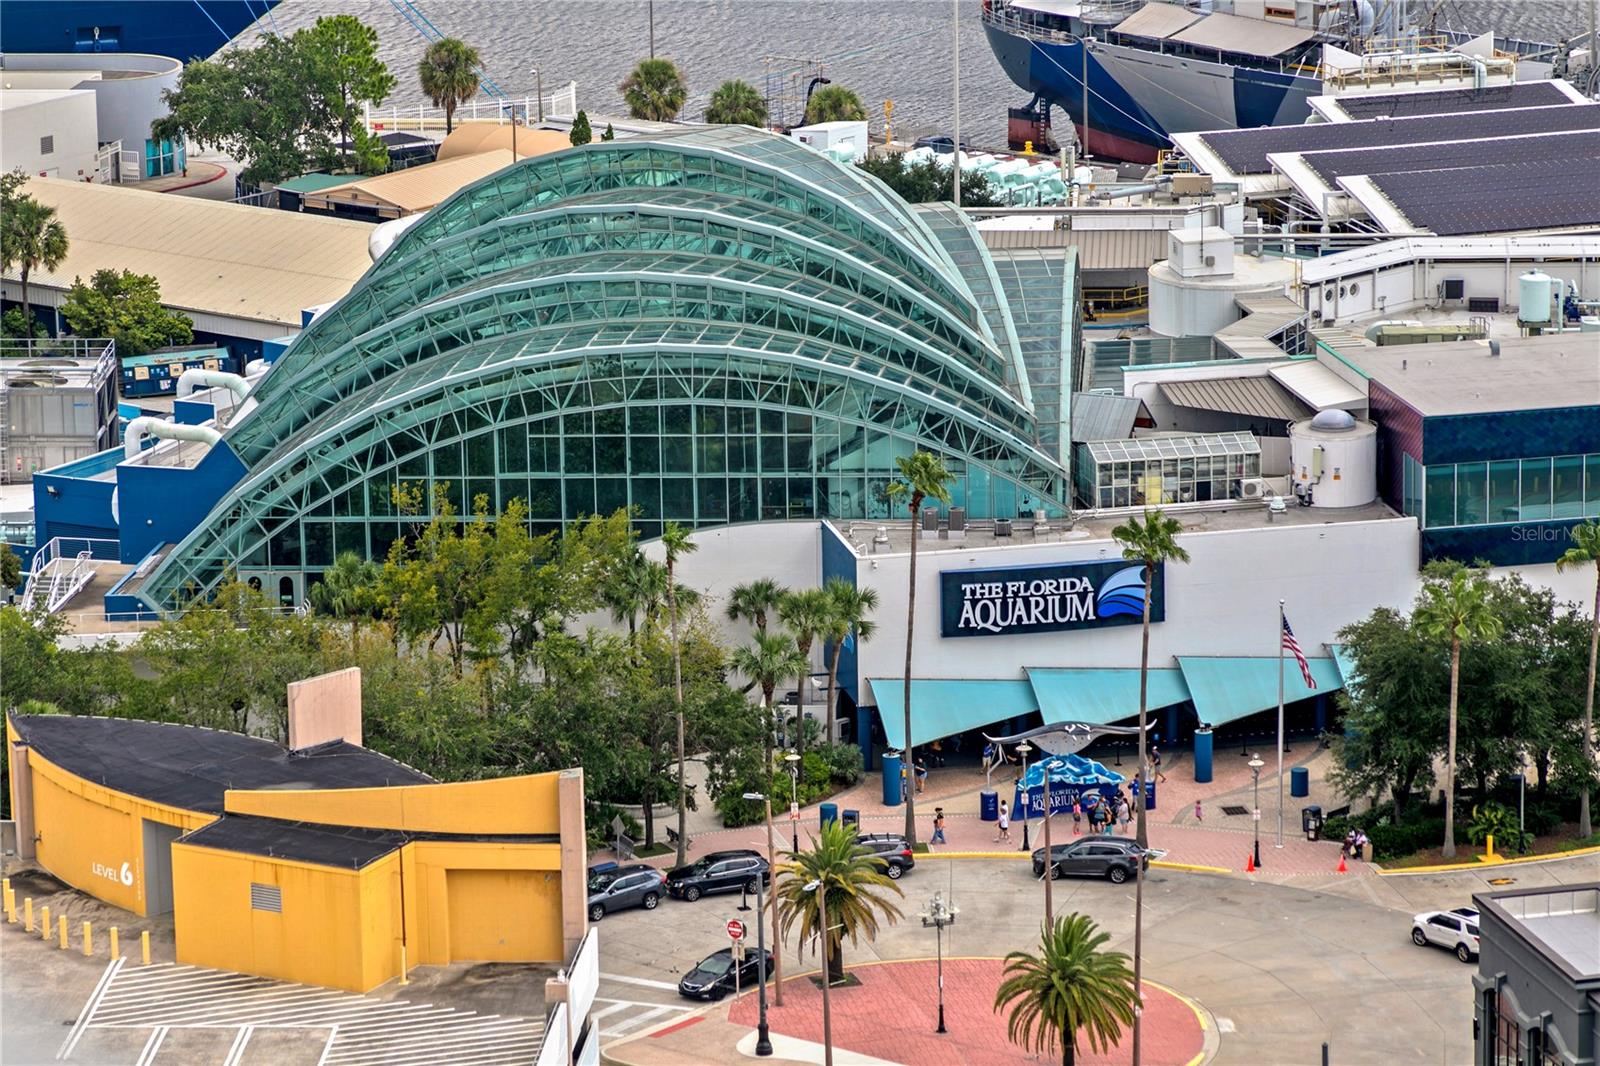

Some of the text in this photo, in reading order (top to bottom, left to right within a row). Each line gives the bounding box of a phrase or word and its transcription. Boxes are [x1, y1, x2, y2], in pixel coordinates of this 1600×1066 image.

[962, 577, 1094, 599] THE FLORIDA
[958, 592, 1096, 632] AQUARIUM
[1047, 788, 1080, 798] LORIDA
[92, 862, 119, 882] LEVEL
[120, 862, 133, 886] 6
